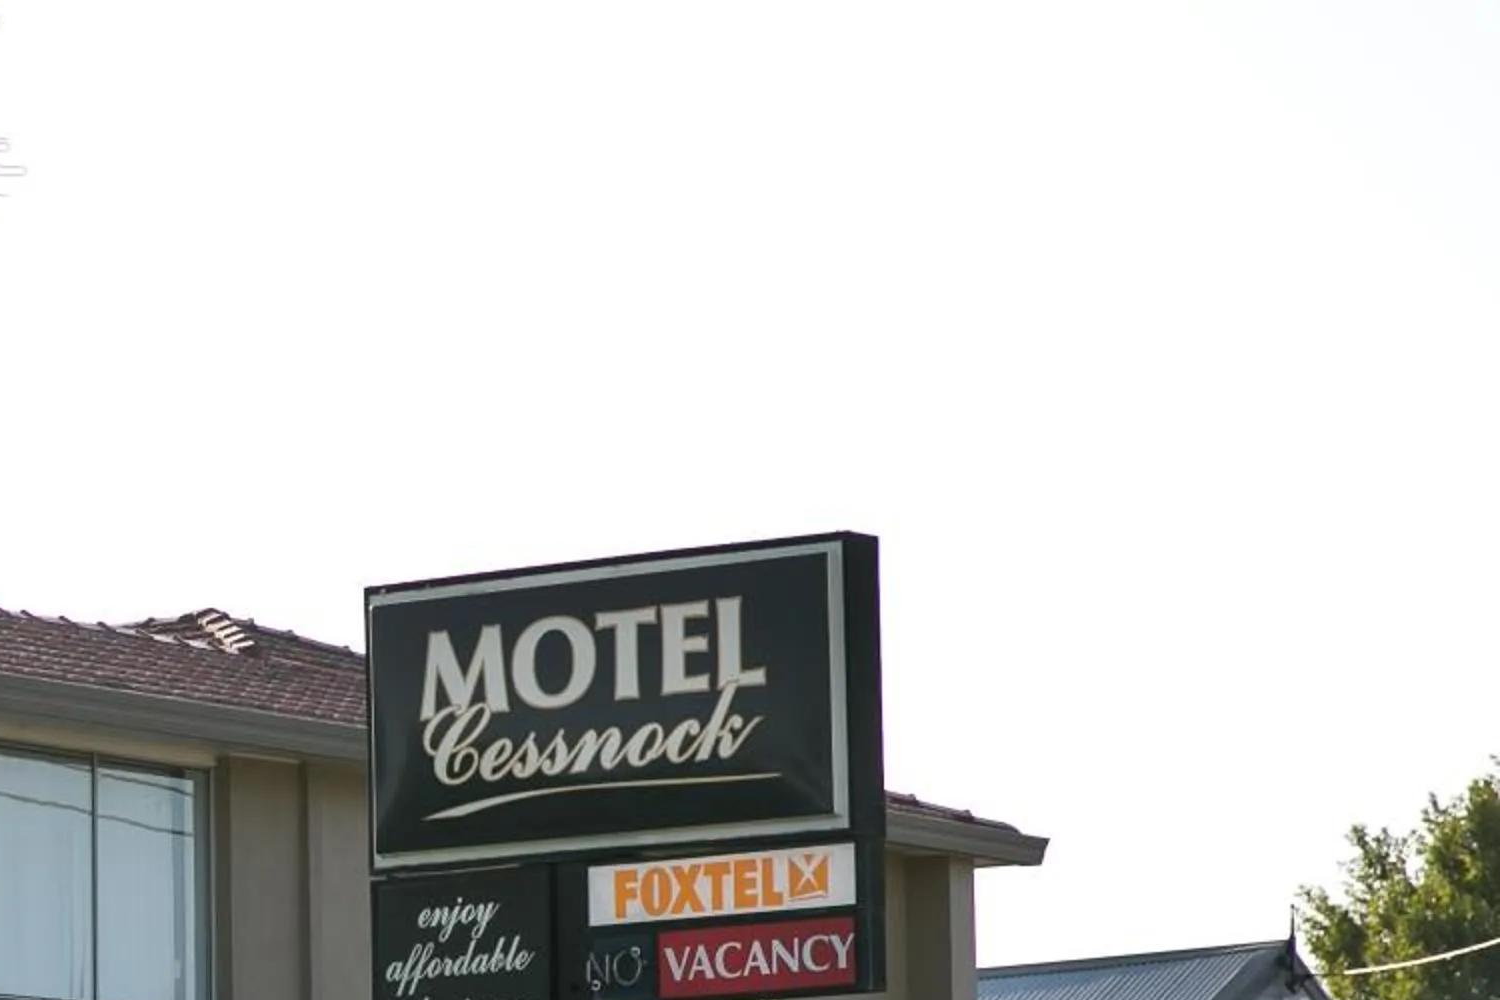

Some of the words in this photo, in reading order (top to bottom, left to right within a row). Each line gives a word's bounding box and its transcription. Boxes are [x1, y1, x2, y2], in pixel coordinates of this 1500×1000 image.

[420, 597, 766, 722] MOTEL
[423, 679, 766, 786] Cessnock
[613, 857, 783, 919] FOXTEL
[417, 897, 500, 943] enjoy
[385, 935, 535, 997] affordable
[586, 946, 643, 991] NO
[663, 932, 854, 981] VACANCY
